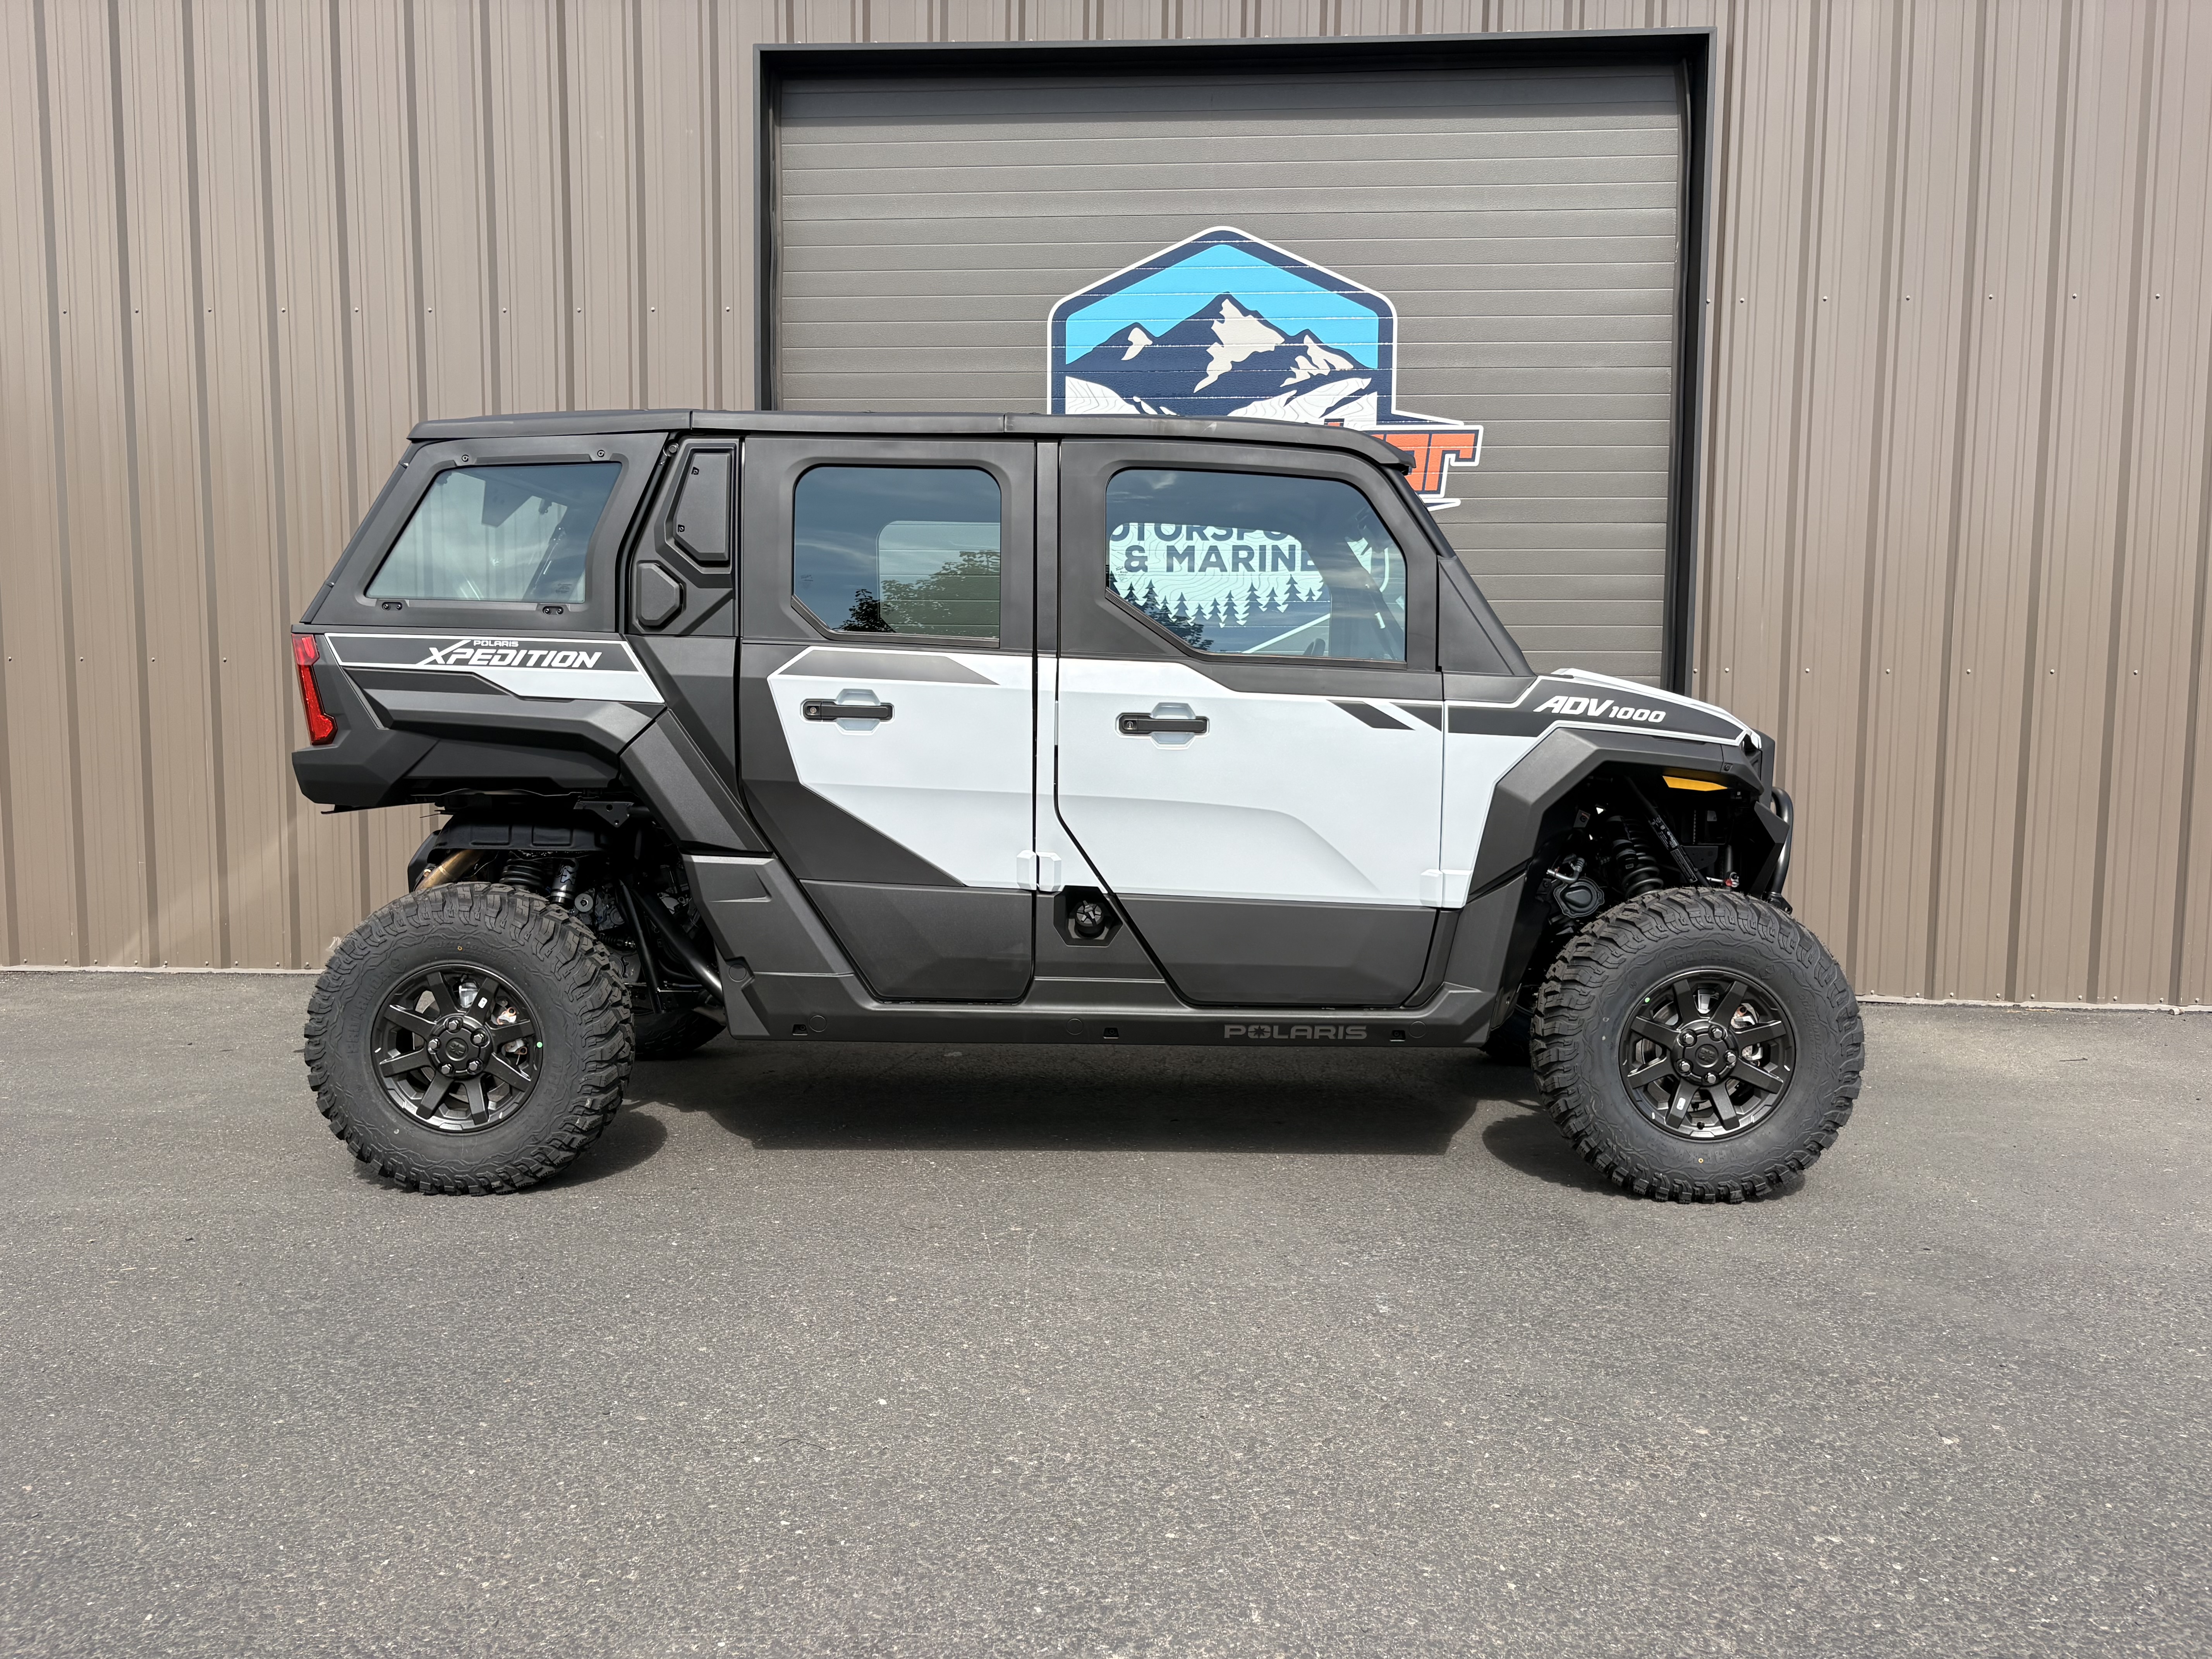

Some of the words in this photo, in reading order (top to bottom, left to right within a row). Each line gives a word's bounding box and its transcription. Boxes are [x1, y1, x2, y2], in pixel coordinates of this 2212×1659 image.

[1124, 545, 1148, 572] &
[416, 640, 602, 668] XPEDITION
[1533, 696, 1614, 716] ADV
[1608, 706, 1666, 723] 1000
[1224, 1024, 1367, 1039] POLARIS
